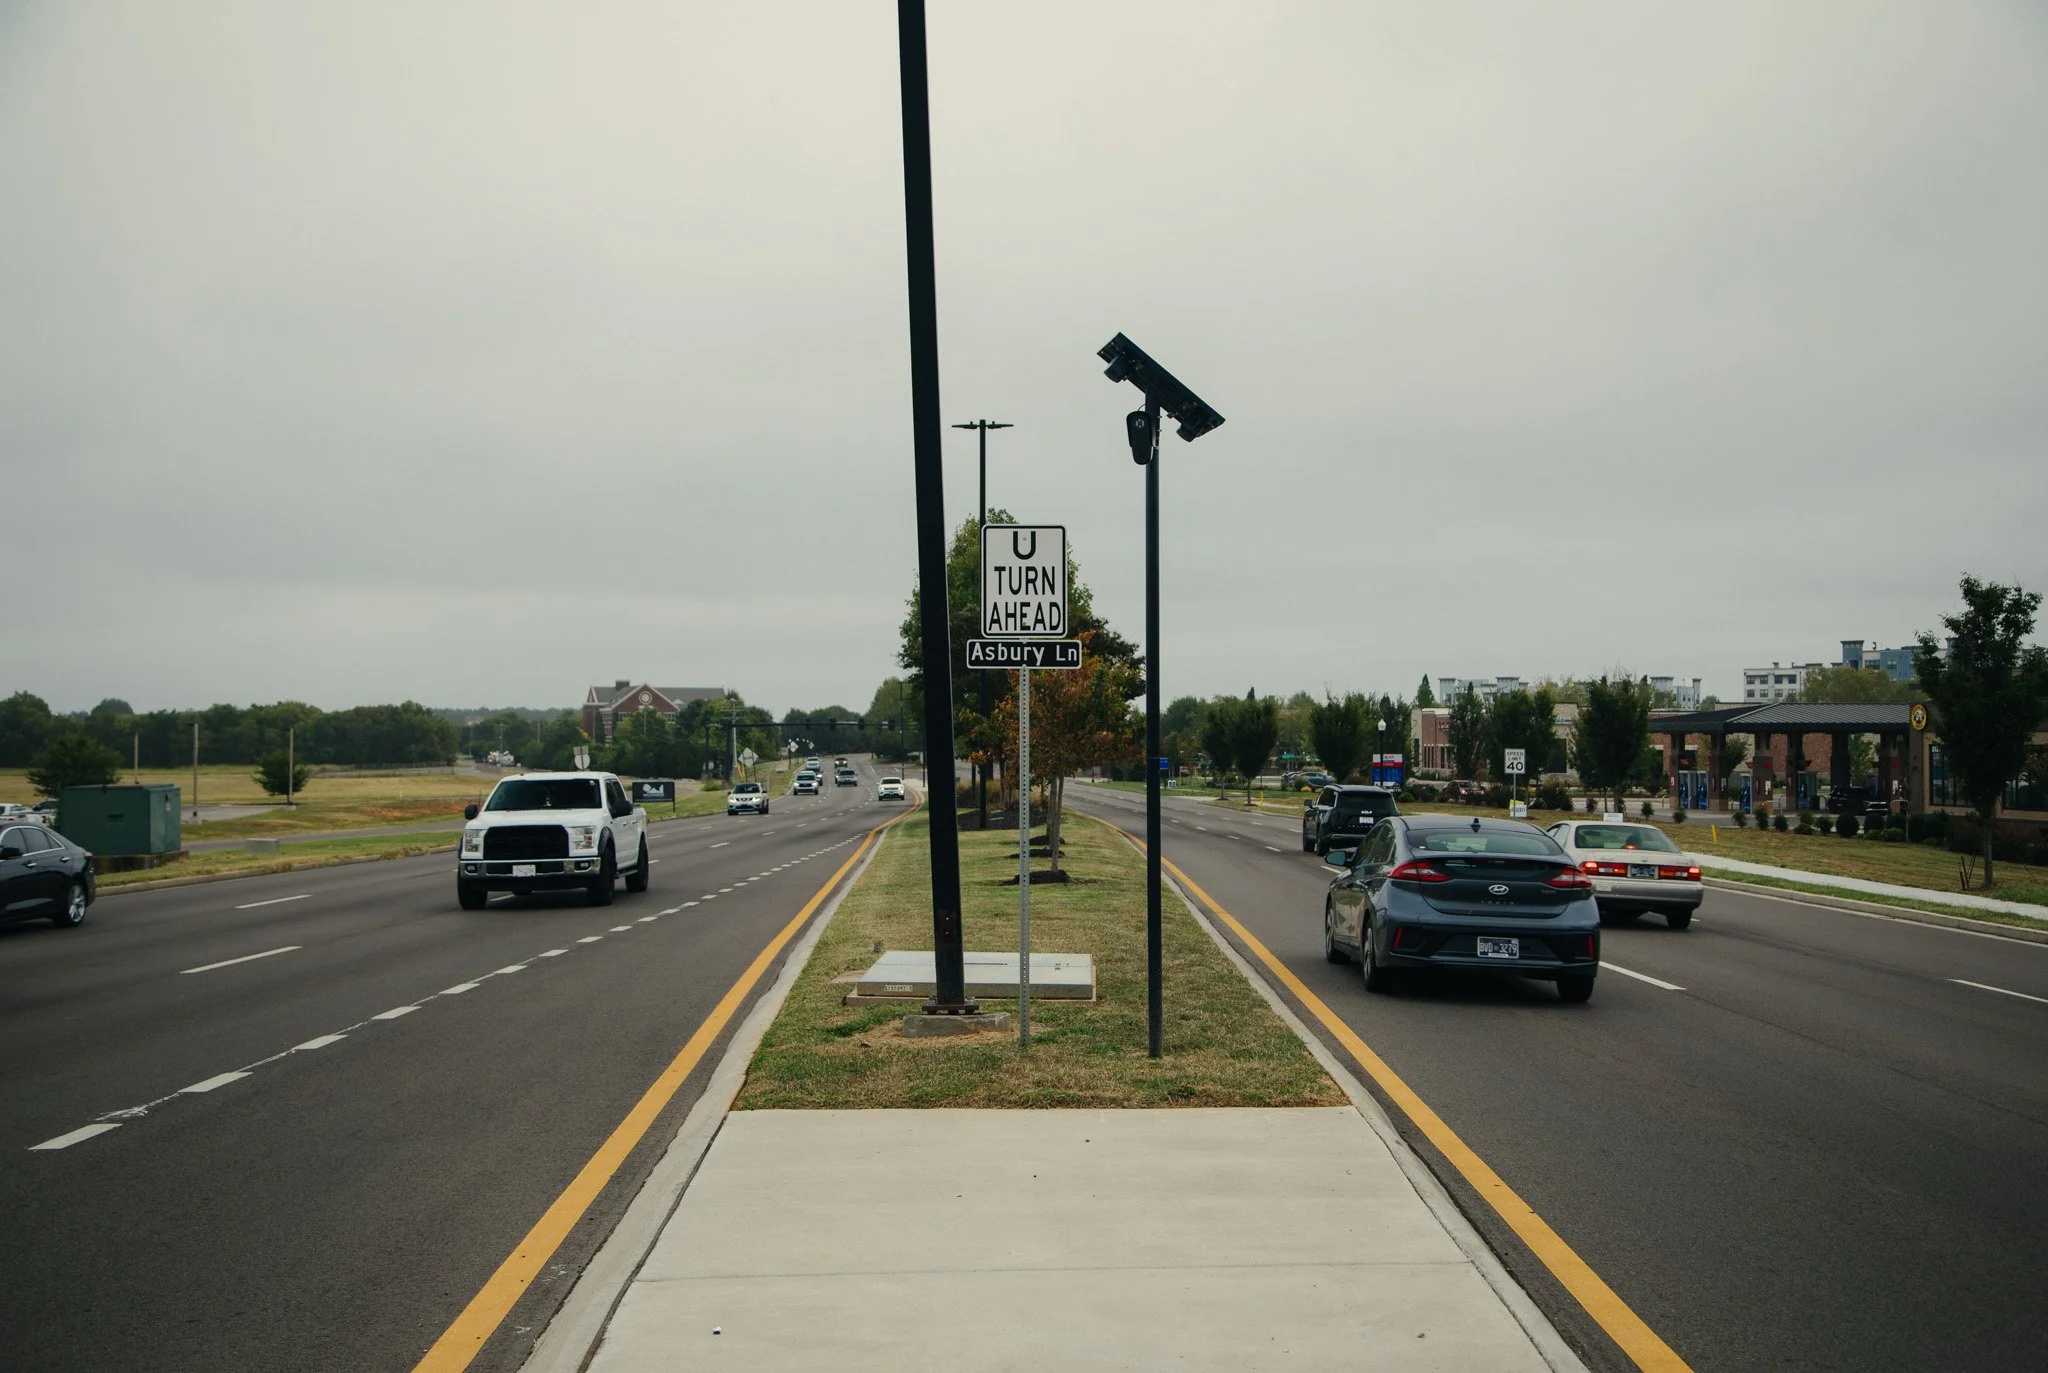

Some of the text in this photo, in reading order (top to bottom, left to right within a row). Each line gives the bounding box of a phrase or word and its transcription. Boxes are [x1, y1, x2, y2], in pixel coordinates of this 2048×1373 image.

[1013, 531, 1036, 560] U
[994, 566, 1055, 595] TURN
[988, 602, 1061, 631] AHEAD
[971, 642, 1077, 666] Asbury Ln
[1506, 761, 1524, 771] 40
